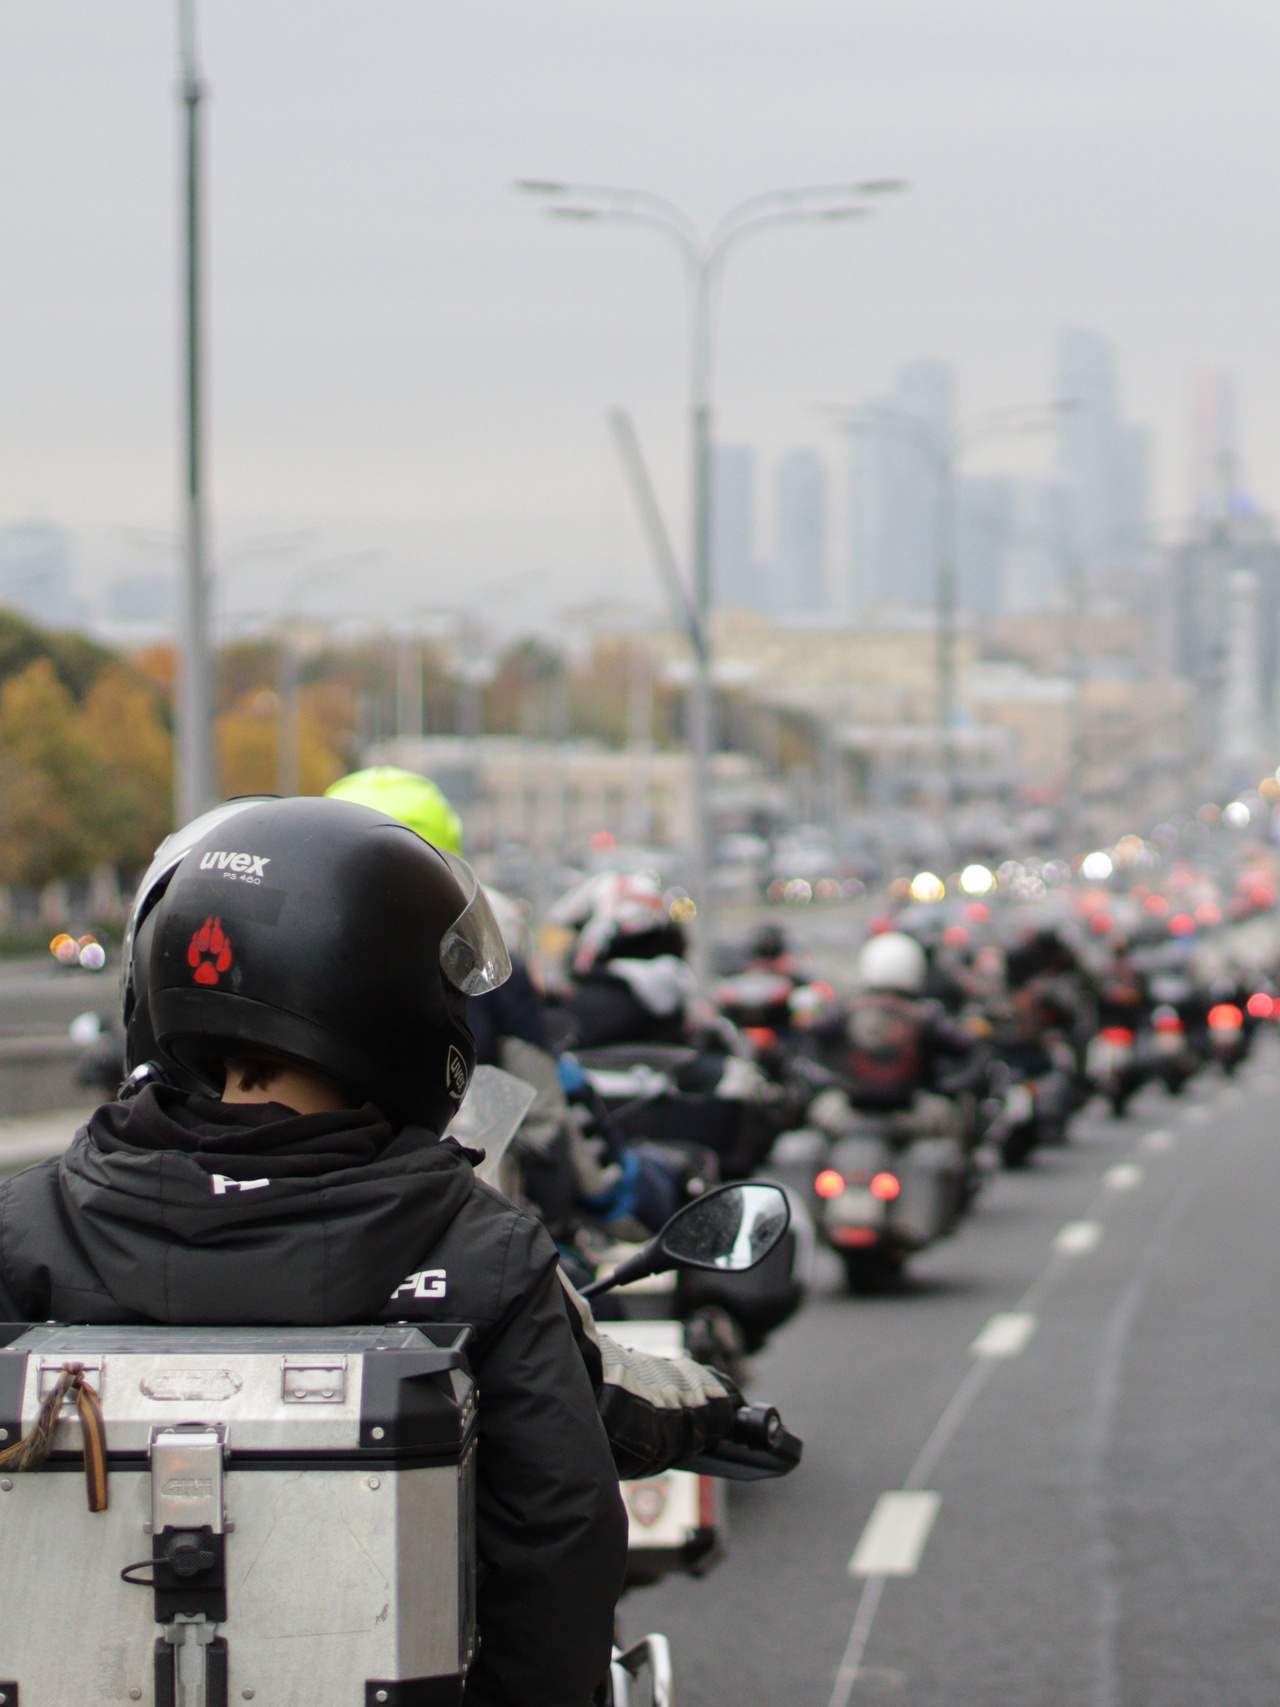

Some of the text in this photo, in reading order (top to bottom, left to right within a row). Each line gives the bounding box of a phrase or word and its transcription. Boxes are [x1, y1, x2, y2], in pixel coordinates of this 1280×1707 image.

[199, 851, 271, 877] uvex
[223, 872, 262, 885] PS 480
